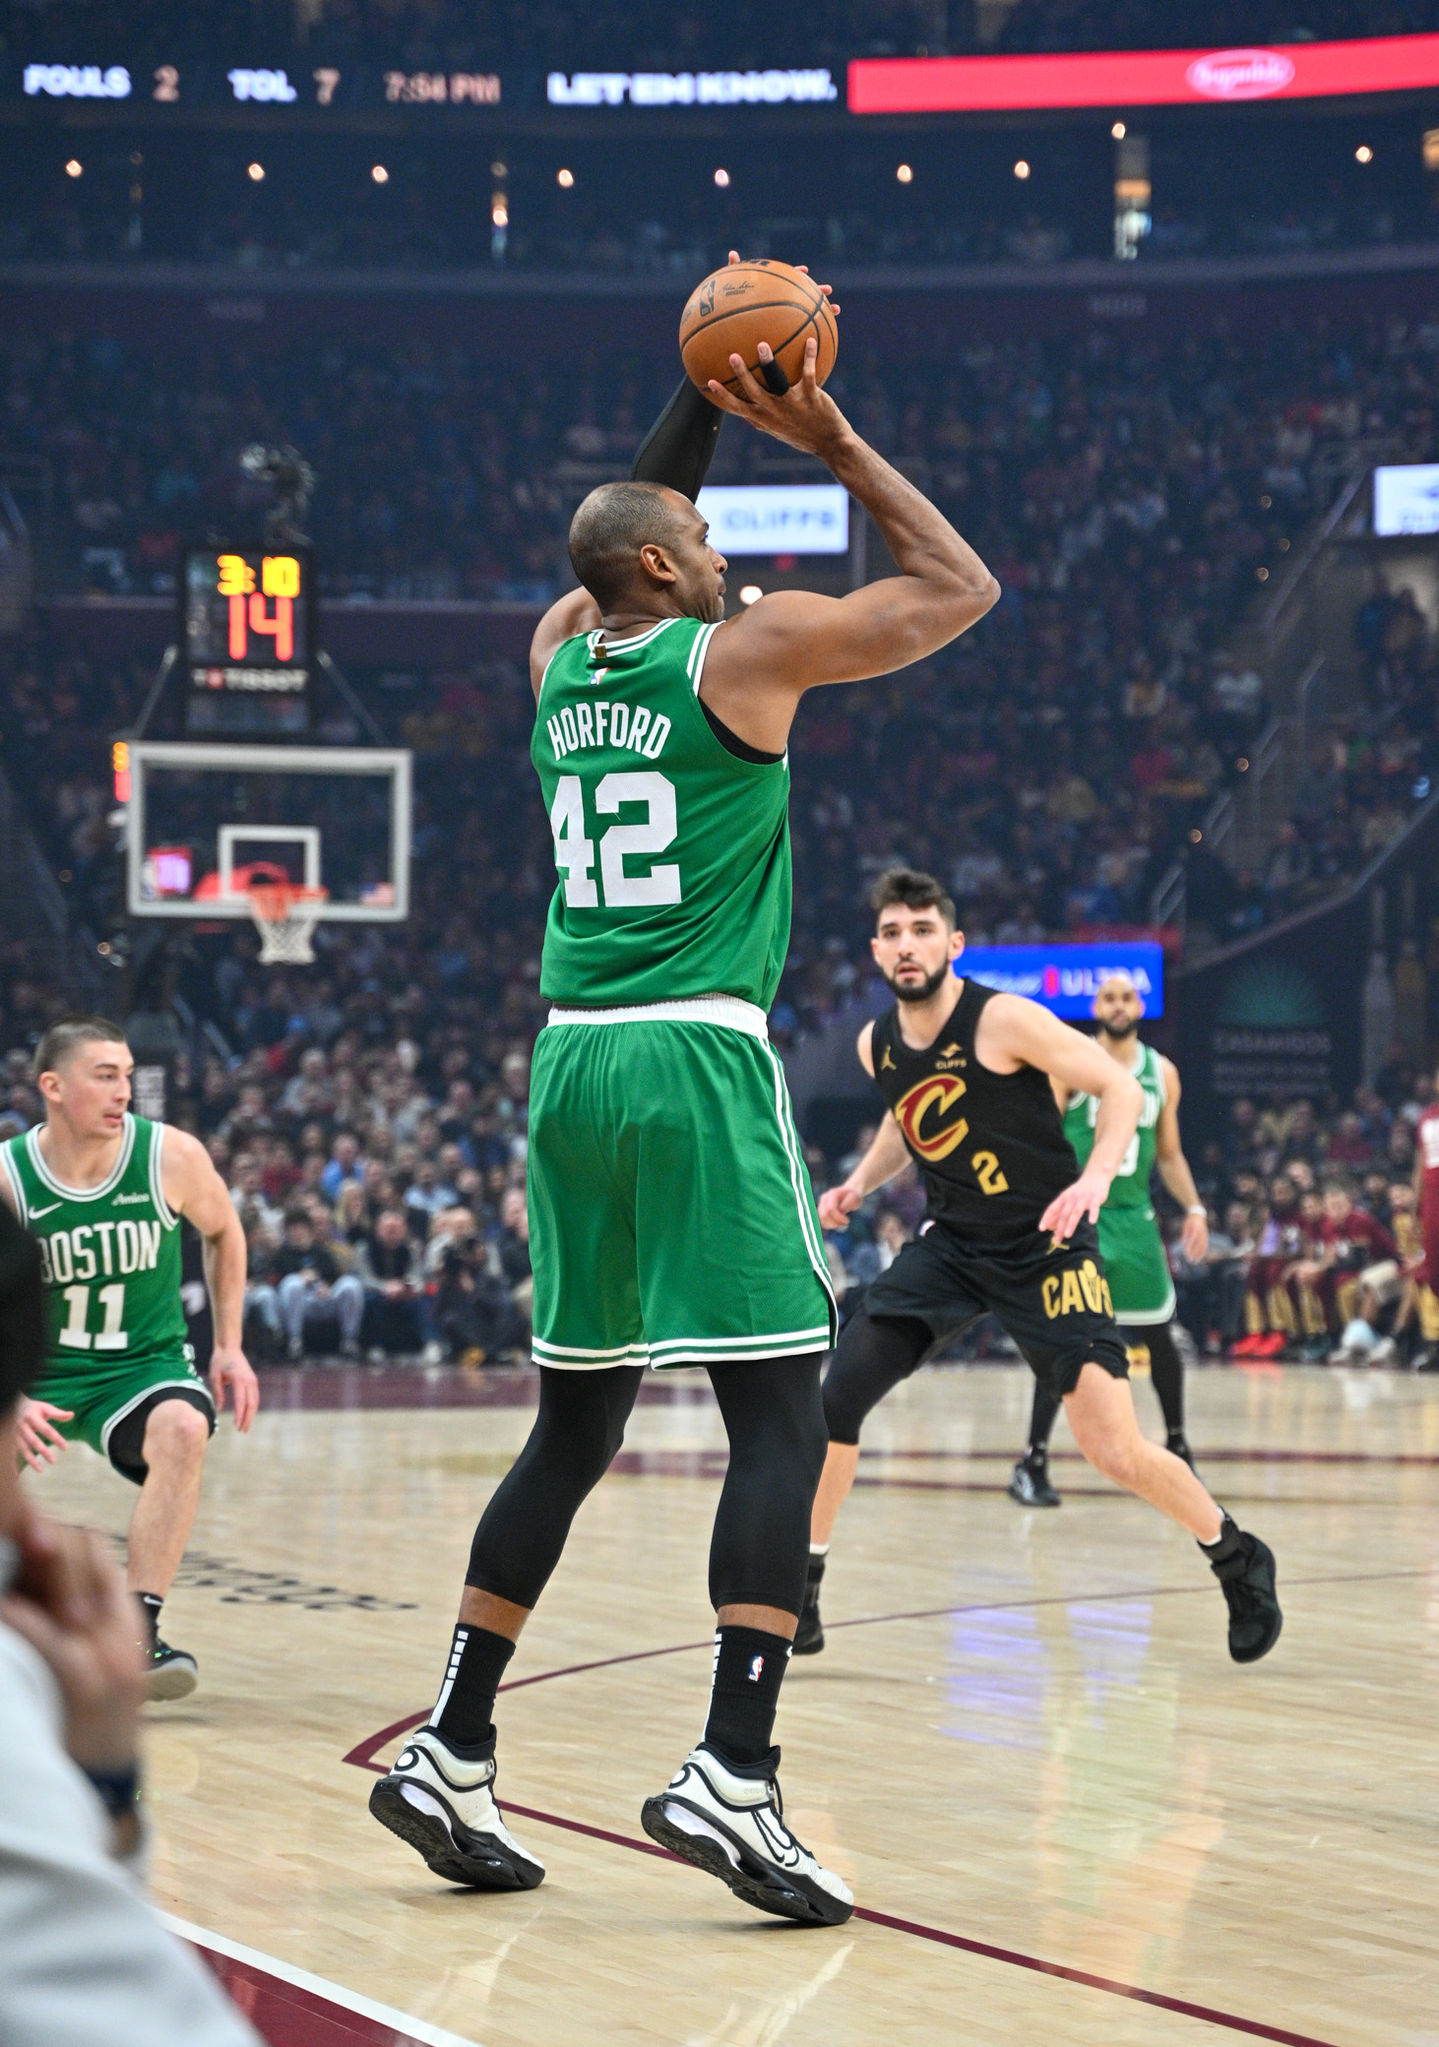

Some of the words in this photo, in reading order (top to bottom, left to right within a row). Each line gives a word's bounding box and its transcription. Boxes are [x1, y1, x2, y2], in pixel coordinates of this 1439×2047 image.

[23, 64, 132, 98] FOULS
[152, 65, 179, 102] 2
[227, 68, 297, 102] TOL
[313, 67, 340, 105] 7
[449, 73, 501, 104] PM
[217, 554, 300, 598] 3:10
[229, 592, 293, 661] 14
[547, 701, 671, 761] HORFORD
[550, 771, 682, 908] 42
[935, 1058, 967, 1070] CLIFFS
[895, 1073, 969, 1162] C
[971, 1151, 1009, 1195] 2
[58, 1283, 128, 1350] 11
